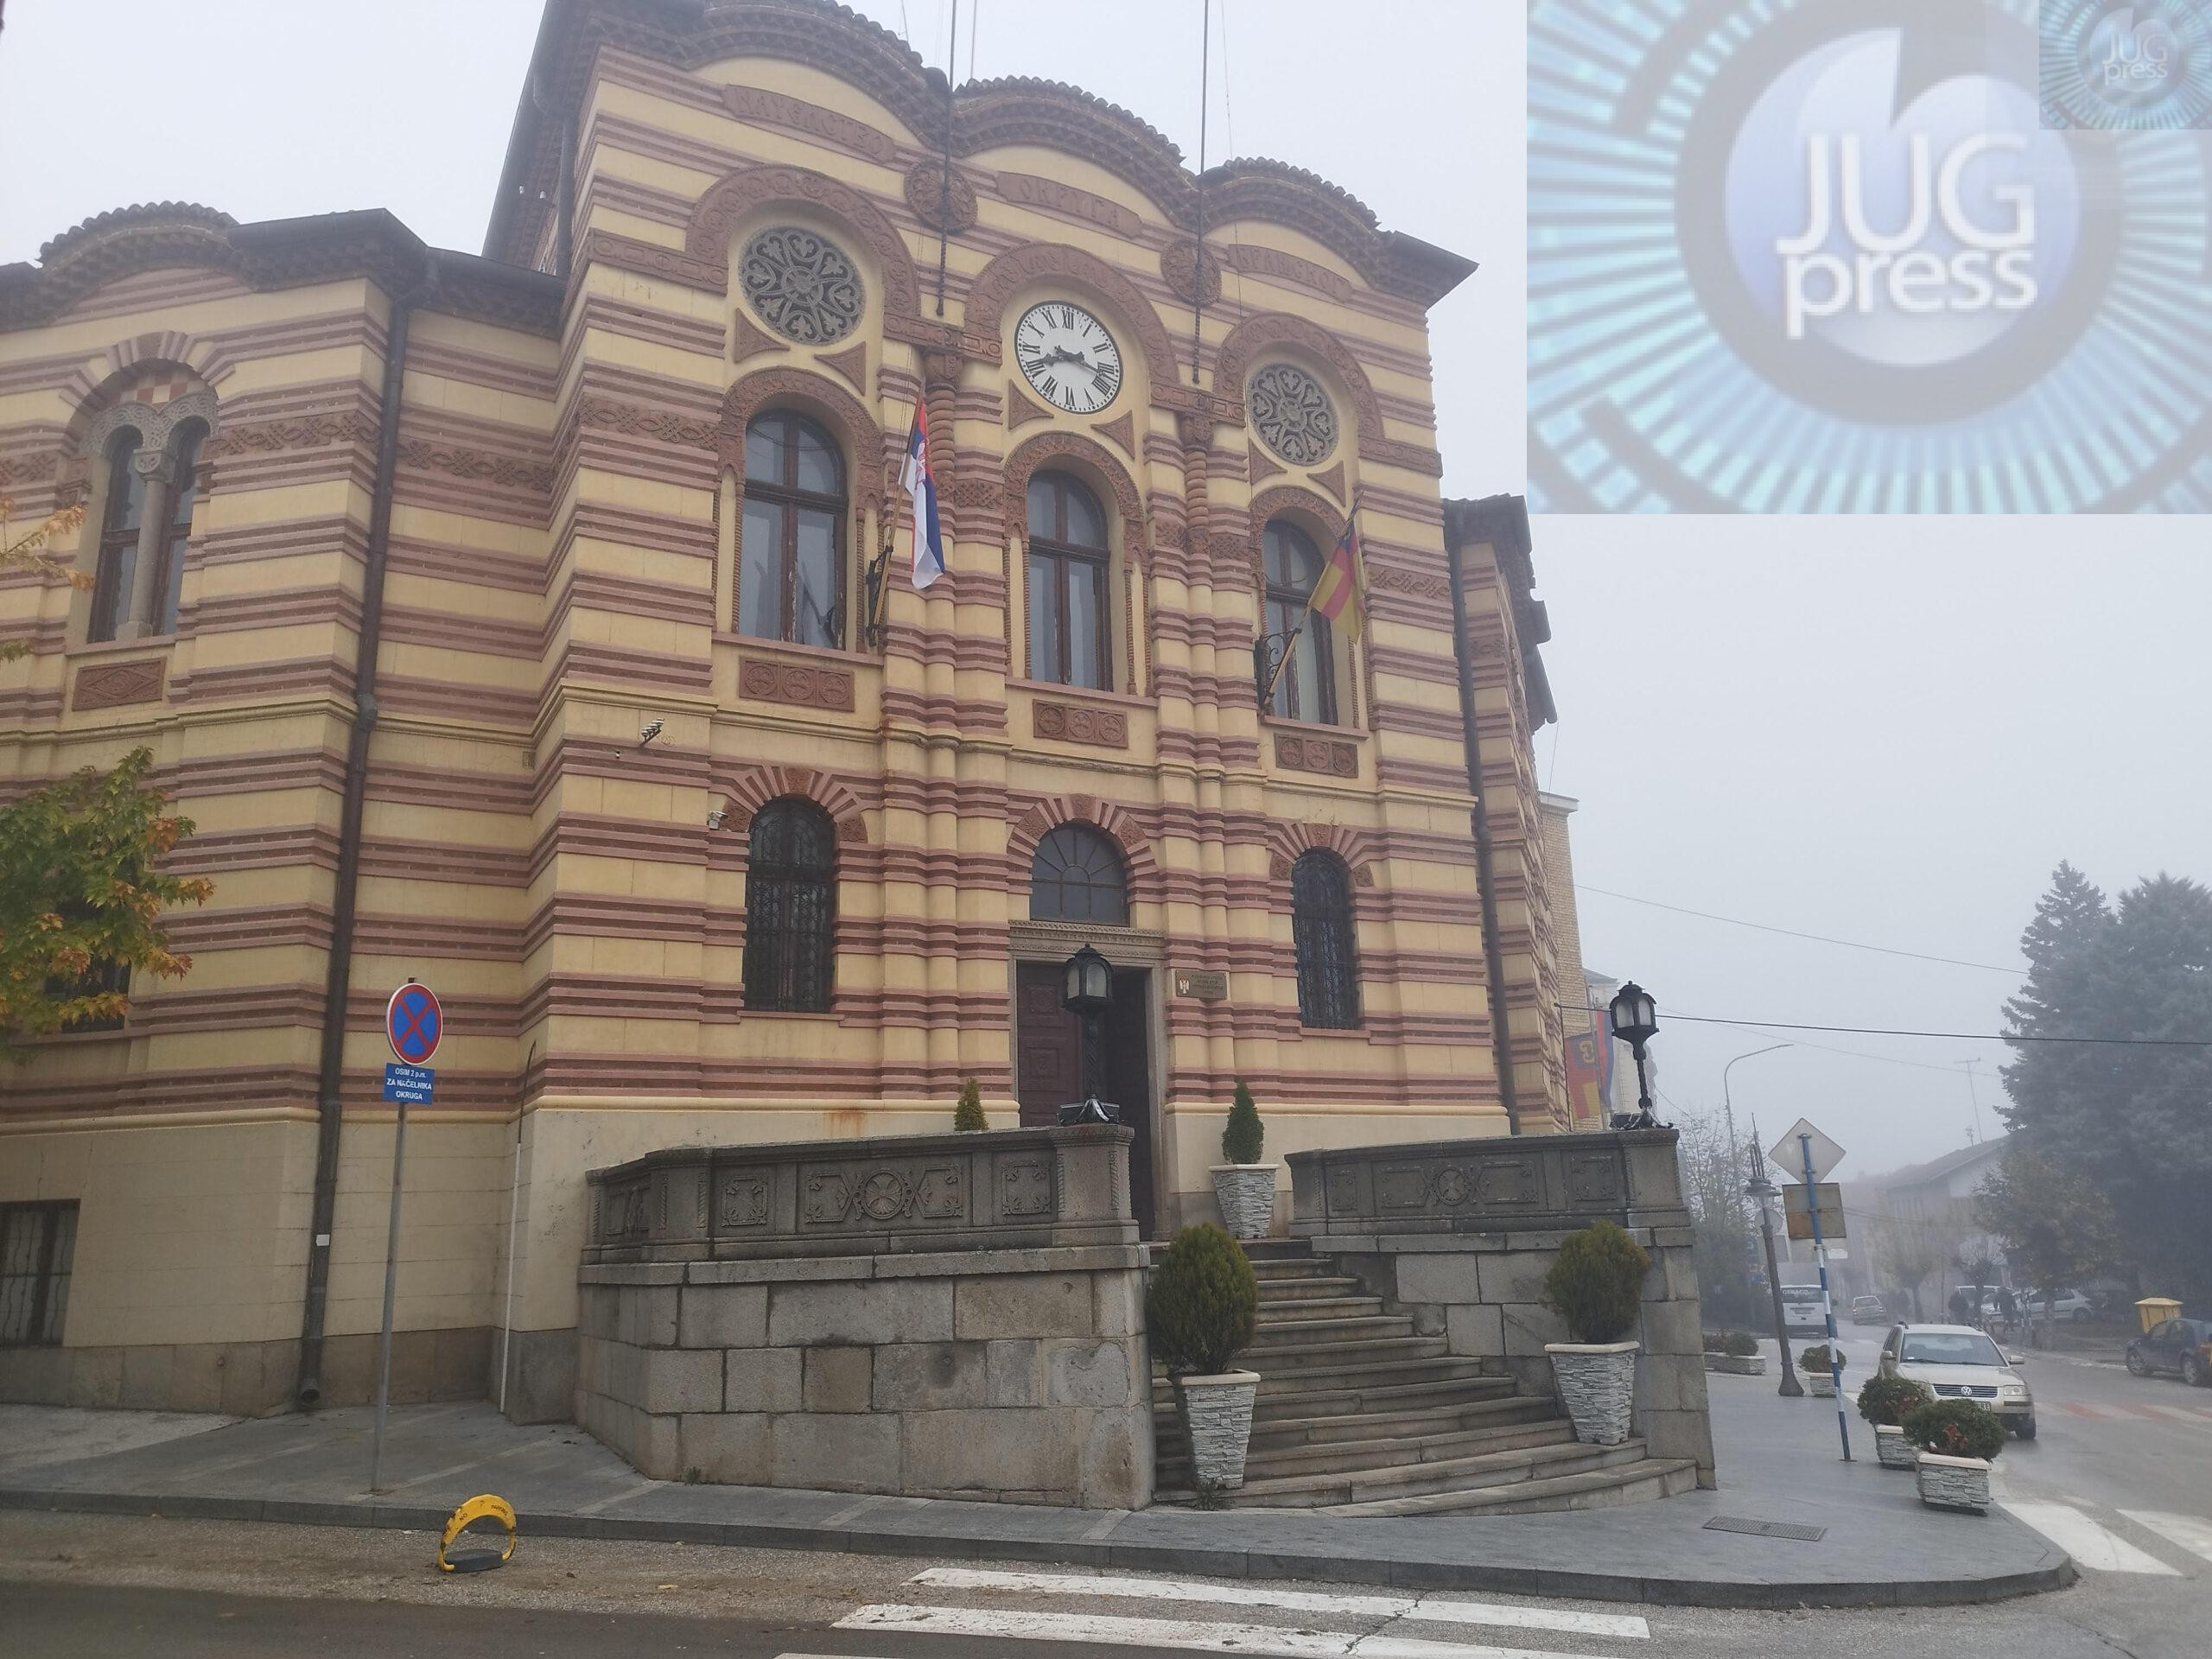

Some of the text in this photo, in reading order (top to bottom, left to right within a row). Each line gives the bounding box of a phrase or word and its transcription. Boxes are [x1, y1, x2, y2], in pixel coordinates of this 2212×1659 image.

[1062, 310, 1074, 330] XII
[1027, 321, 1046, 339] X
[1065, 385, 1076, 407] VI
[397, 1078, 432, 1090] NAČELNIKA
[396, 1090, 423, 1099] OKRUGA
